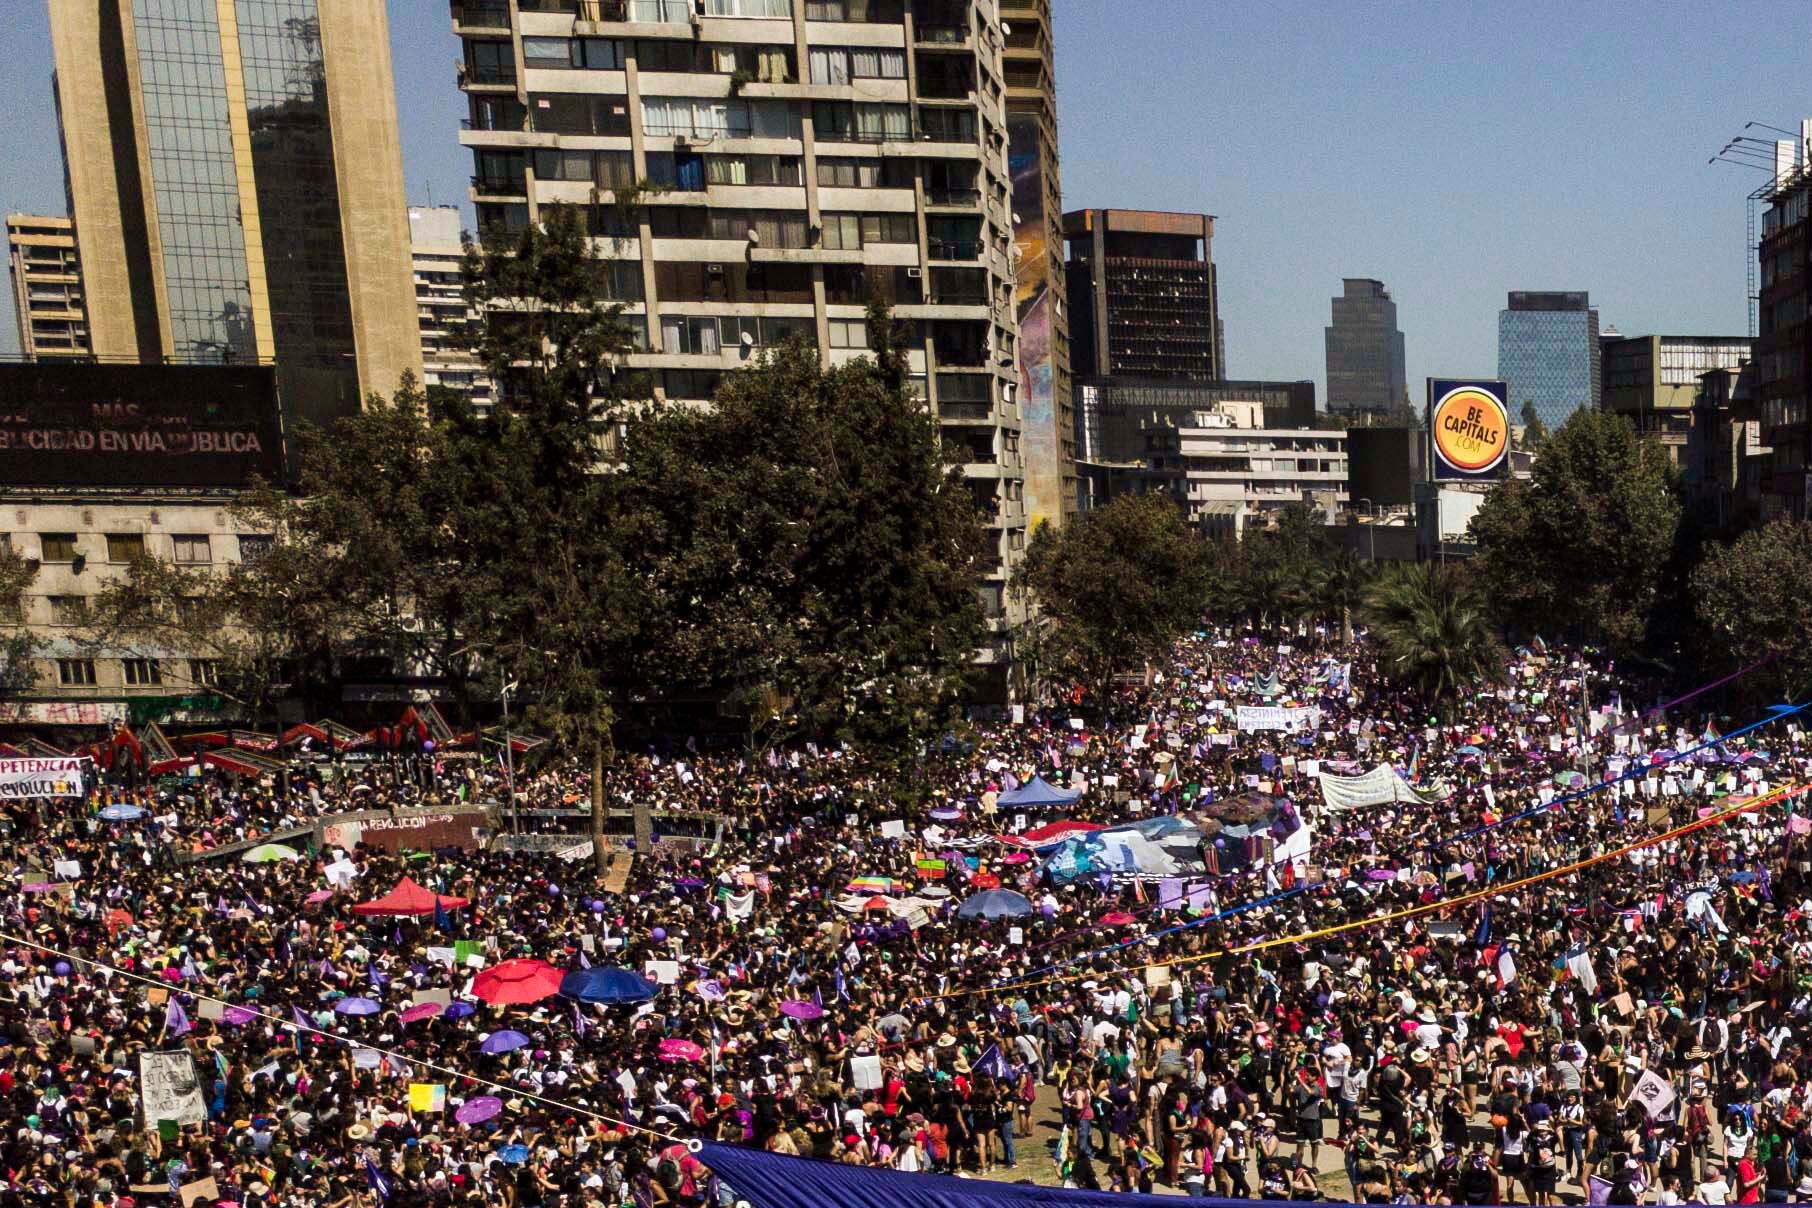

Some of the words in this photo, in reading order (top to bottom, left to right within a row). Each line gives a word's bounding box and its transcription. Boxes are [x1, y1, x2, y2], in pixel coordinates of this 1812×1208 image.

[1467, 405, 1484, 425] BE
[100, 430, 129, 451] EN
[1443, 414, 1500, 446] CAPITALS
